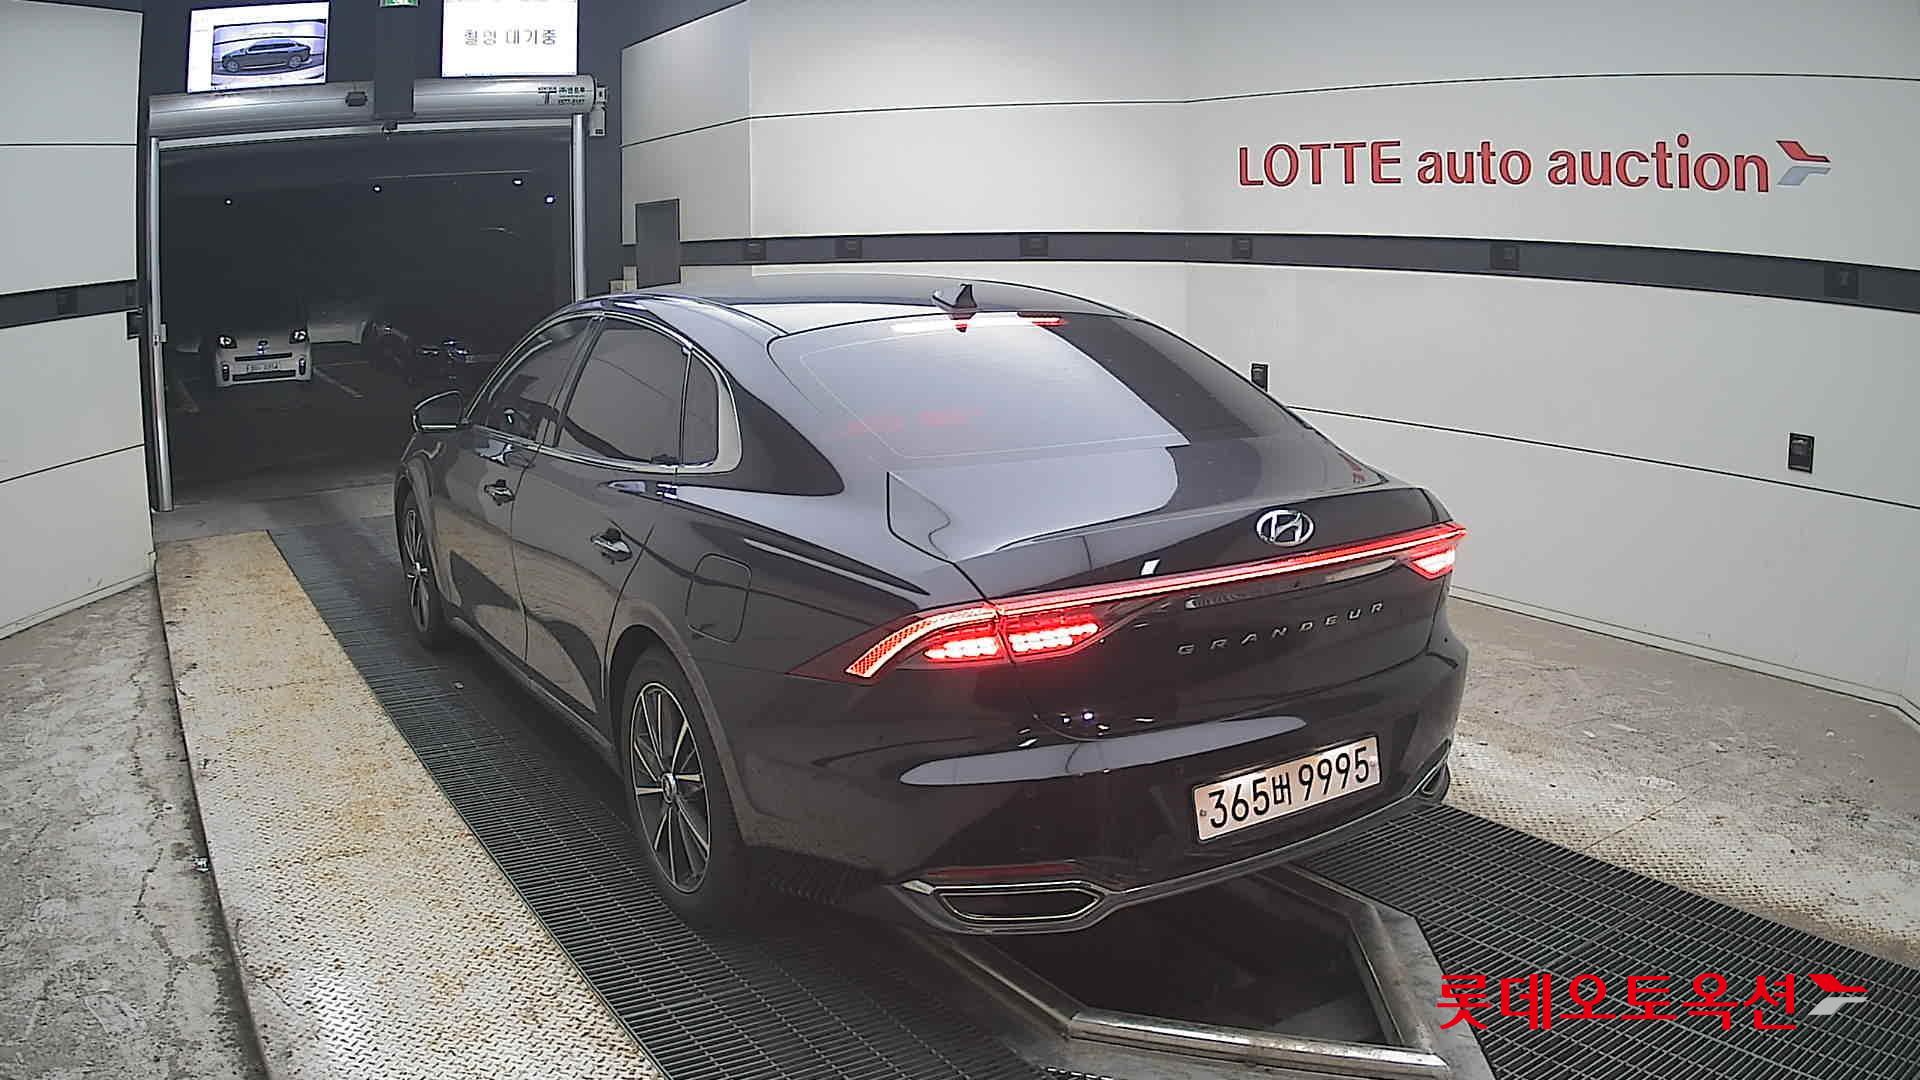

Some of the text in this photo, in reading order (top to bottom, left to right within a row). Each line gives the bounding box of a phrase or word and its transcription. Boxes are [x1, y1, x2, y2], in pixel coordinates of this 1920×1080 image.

[1238, 133, 1770, 193] LOTTE auto auction
[1178, 602, 1384, 656] GRANDEUR
[1208, 746, 1370, 828] 365버 9995
